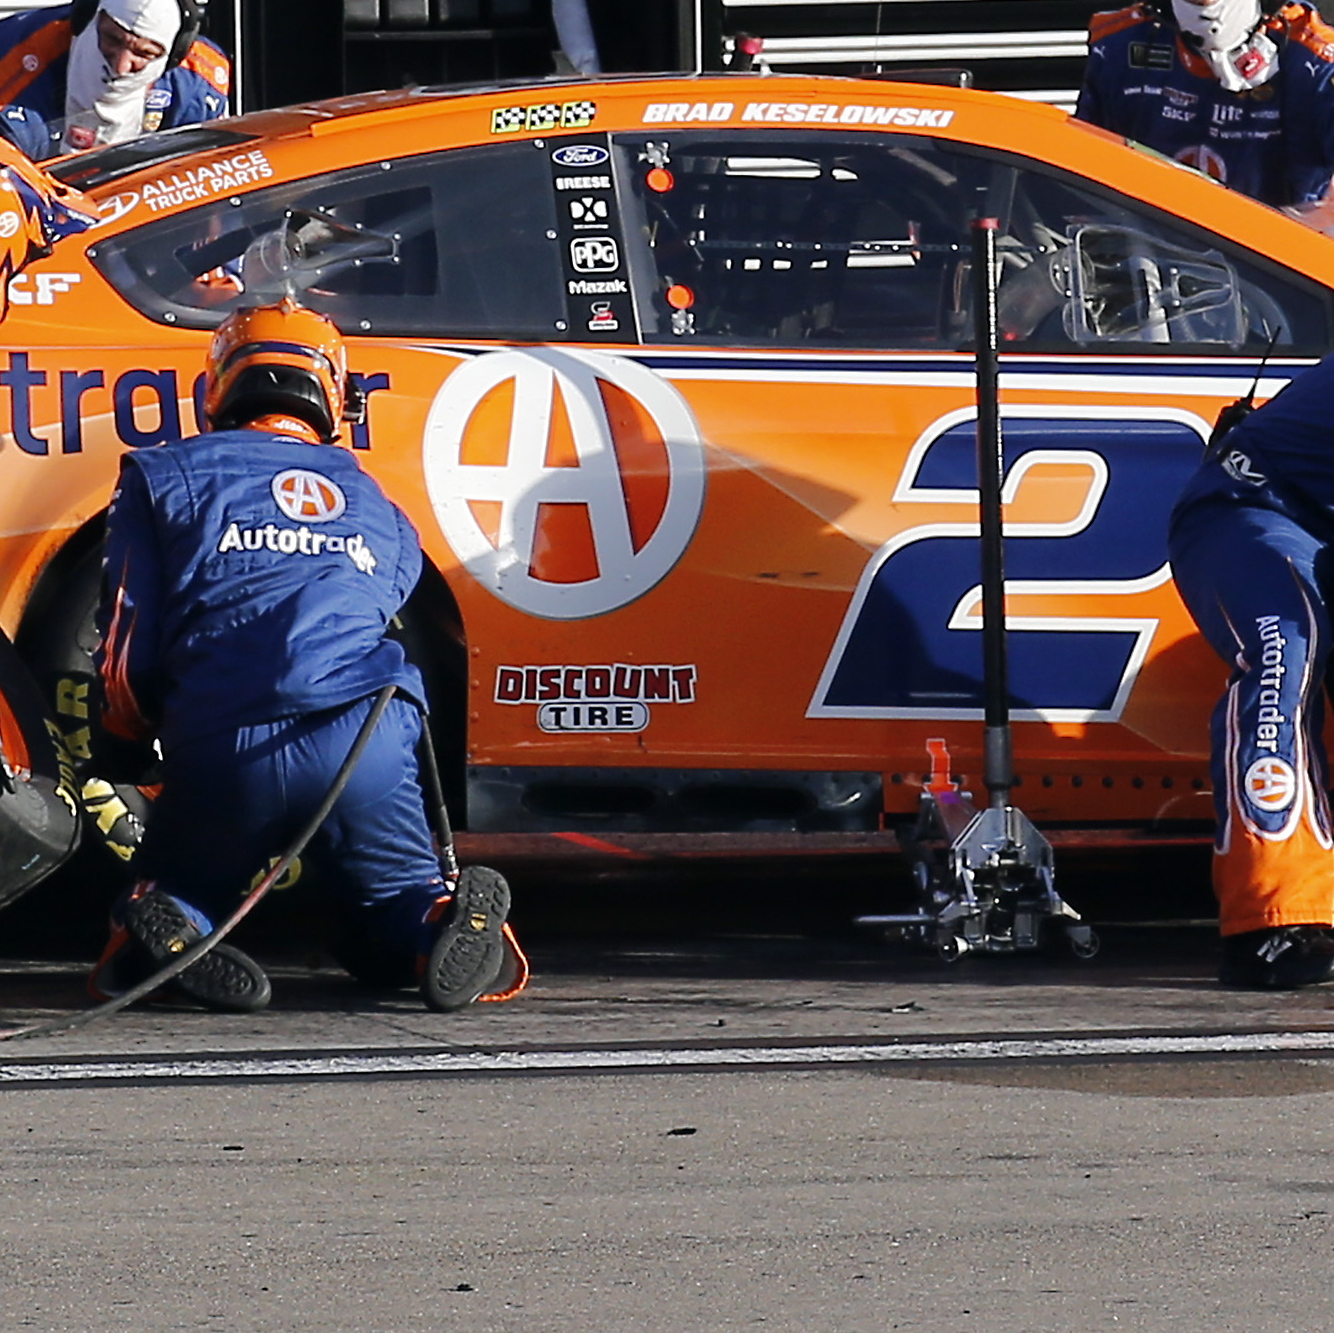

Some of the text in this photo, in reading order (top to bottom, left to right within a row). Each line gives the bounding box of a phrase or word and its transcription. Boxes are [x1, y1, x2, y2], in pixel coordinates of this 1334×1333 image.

[642, 103, 955, 127] BRAD KESELOWSKI
[142, 150, 267, 197] ALLIANCE
[147, 164, 274, 213] TRUCK PARTS
[563, 176, 611, 190] REESE
[574, 240, 614, 267] PPG
[569, 278, 628, 294] Mazak
[219, 523, 376, 576] Autotrader
[805, 403, 1214, 722] 2
[494, 663, 698, 704] DISCOUNT
[1255, 615, 1287, 754] Autotrader
[549, 705, 635, 727] TIRE
